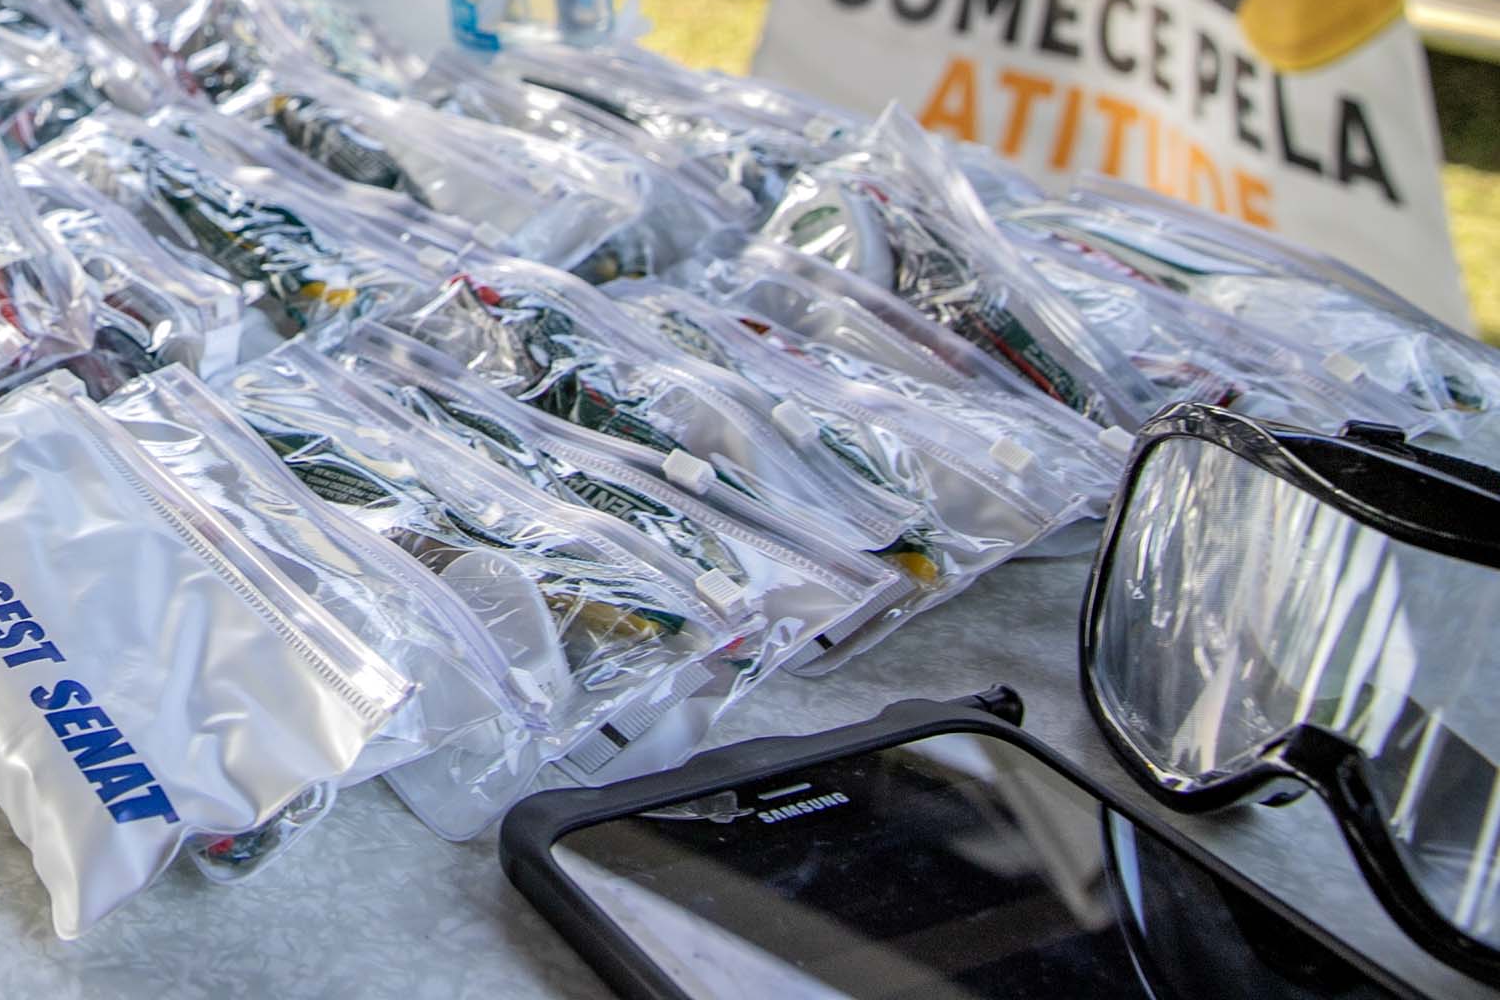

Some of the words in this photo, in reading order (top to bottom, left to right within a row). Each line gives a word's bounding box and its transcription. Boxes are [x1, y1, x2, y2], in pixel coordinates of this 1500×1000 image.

[916, 56, 1276, 228] ATITUDE
[1195, 30, 1405, 207] PELA
[30, 679, 180, 824] SENAT
[757, 792, 850, 823] SAMSUNG
